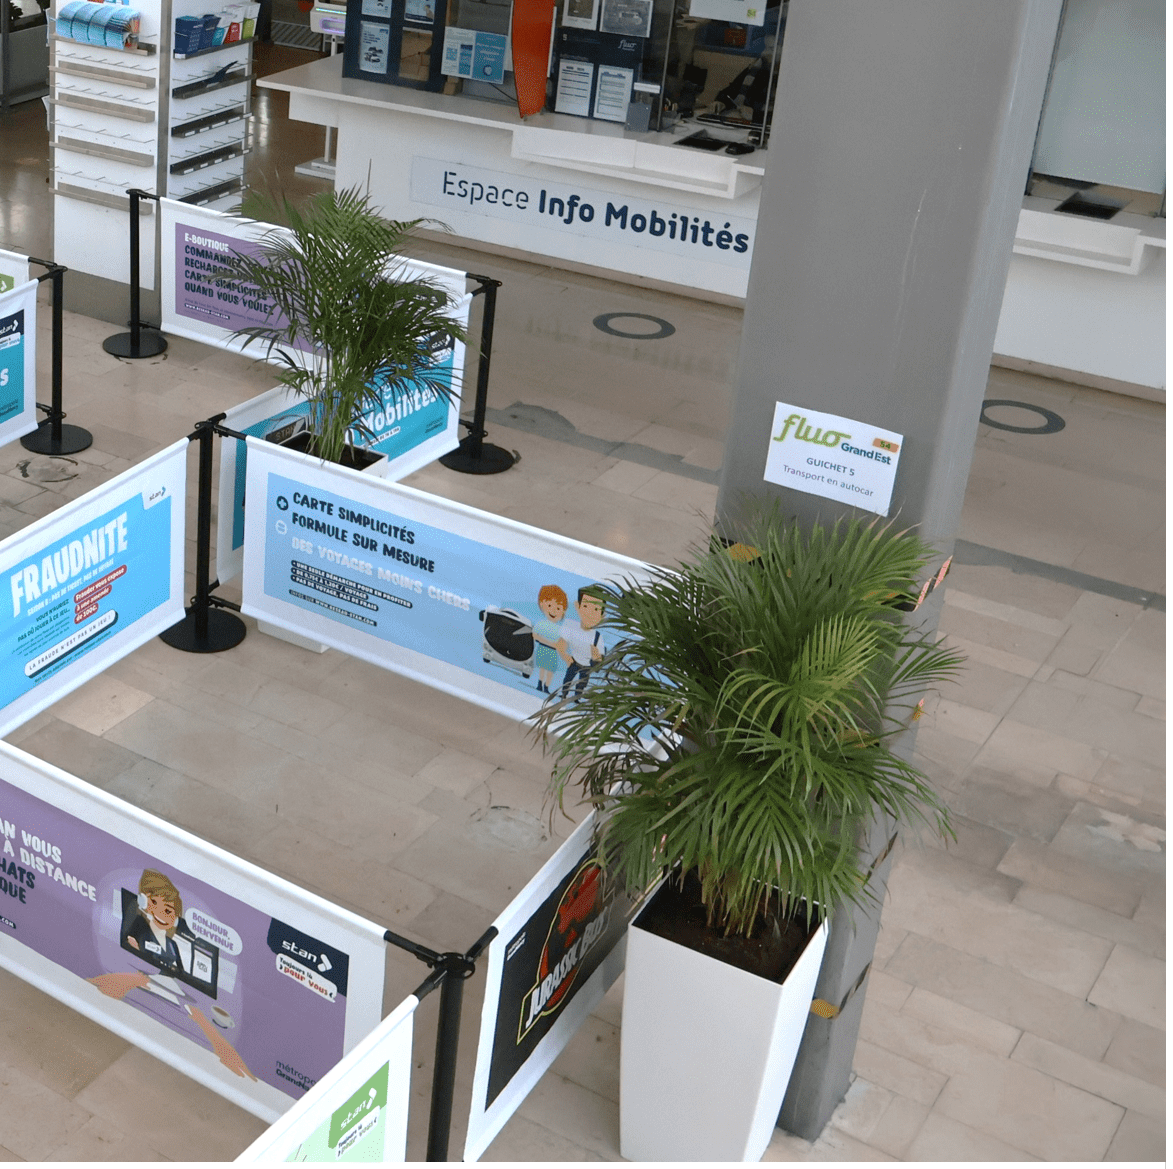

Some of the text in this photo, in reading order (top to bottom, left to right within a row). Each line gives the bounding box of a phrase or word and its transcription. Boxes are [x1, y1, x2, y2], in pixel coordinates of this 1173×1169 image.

[443, 171, 749, 253] Espace Info Mobilités
[184, 232, 230, 252] E-BOUTIQUE
[185, 282, 214, 298] QUAND
[217, 290, 239, 305] VOUS
[773, 413, 852, 448] fluo
[783, 464, 874, 497] Transport en autocar
[806, 457, 855, 476] GUICHET 5
[149, 490, 162, 502] stan
[293, 491, 415, 545] CARTE SIMPLICITÉS
[292, 512, 435, 573] FORMULE SUR MESURE
[10, 511, 128, 618] FRAUDNITE
[292, 536, 471, 611] DES VOYAGES MOINS CHERS
[38, 649, 59, 664] FRAUDE
[21, 829, 62, 864] VOUS
[4, 834, 15, 857] À
[20, 847, 97, 902] DISTANCE
[192, 922, 234, 951] BIENVENUE
[282, 939, 317, 963] stan
[279, 957, 305, 975] Toujours
[284, 965, 328, 996] pour vous
[526, 937, 582, 1029] JURASSIC
[276, 1060, 316, 1086] métropo
[340, 1099, 366, 1131] stan
